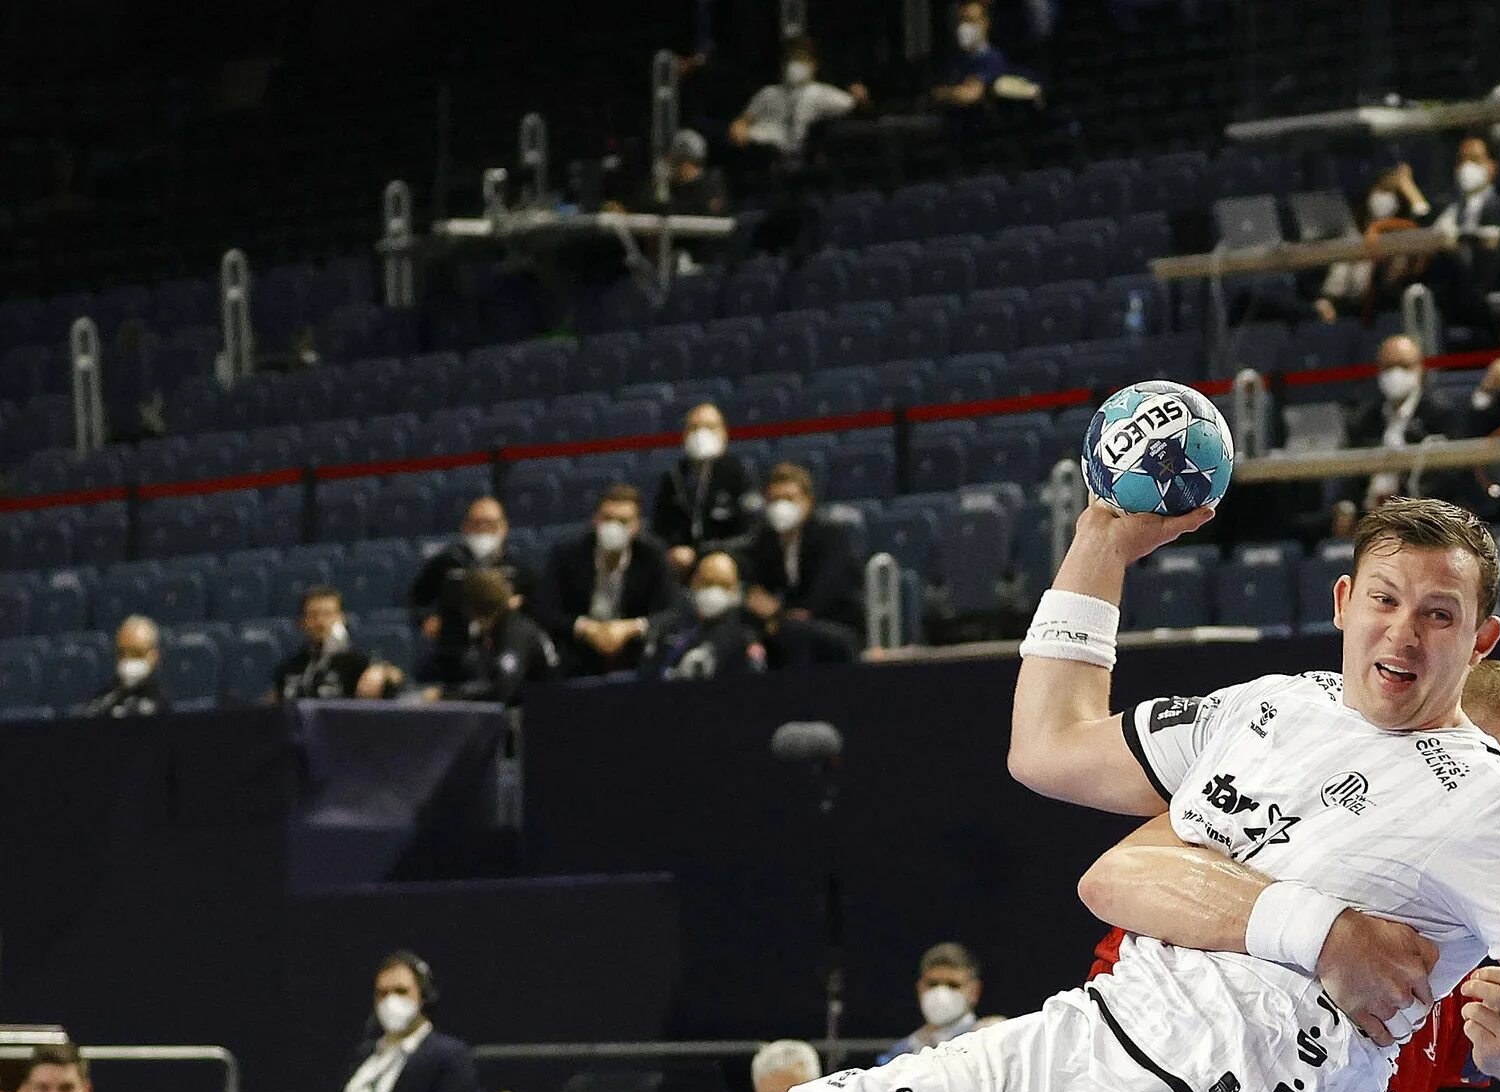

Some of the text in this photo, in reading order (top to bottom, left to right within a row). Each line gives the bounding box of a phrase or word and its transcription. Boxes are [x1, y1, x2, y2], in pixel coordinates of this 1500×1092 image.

[1104, 400, 1183, 465] SELECT
[1415, 739, 1459, 792] CULINAR
[1202, 773, 1260, 815] star
[1338, 797, 1366, 816] KIEL
